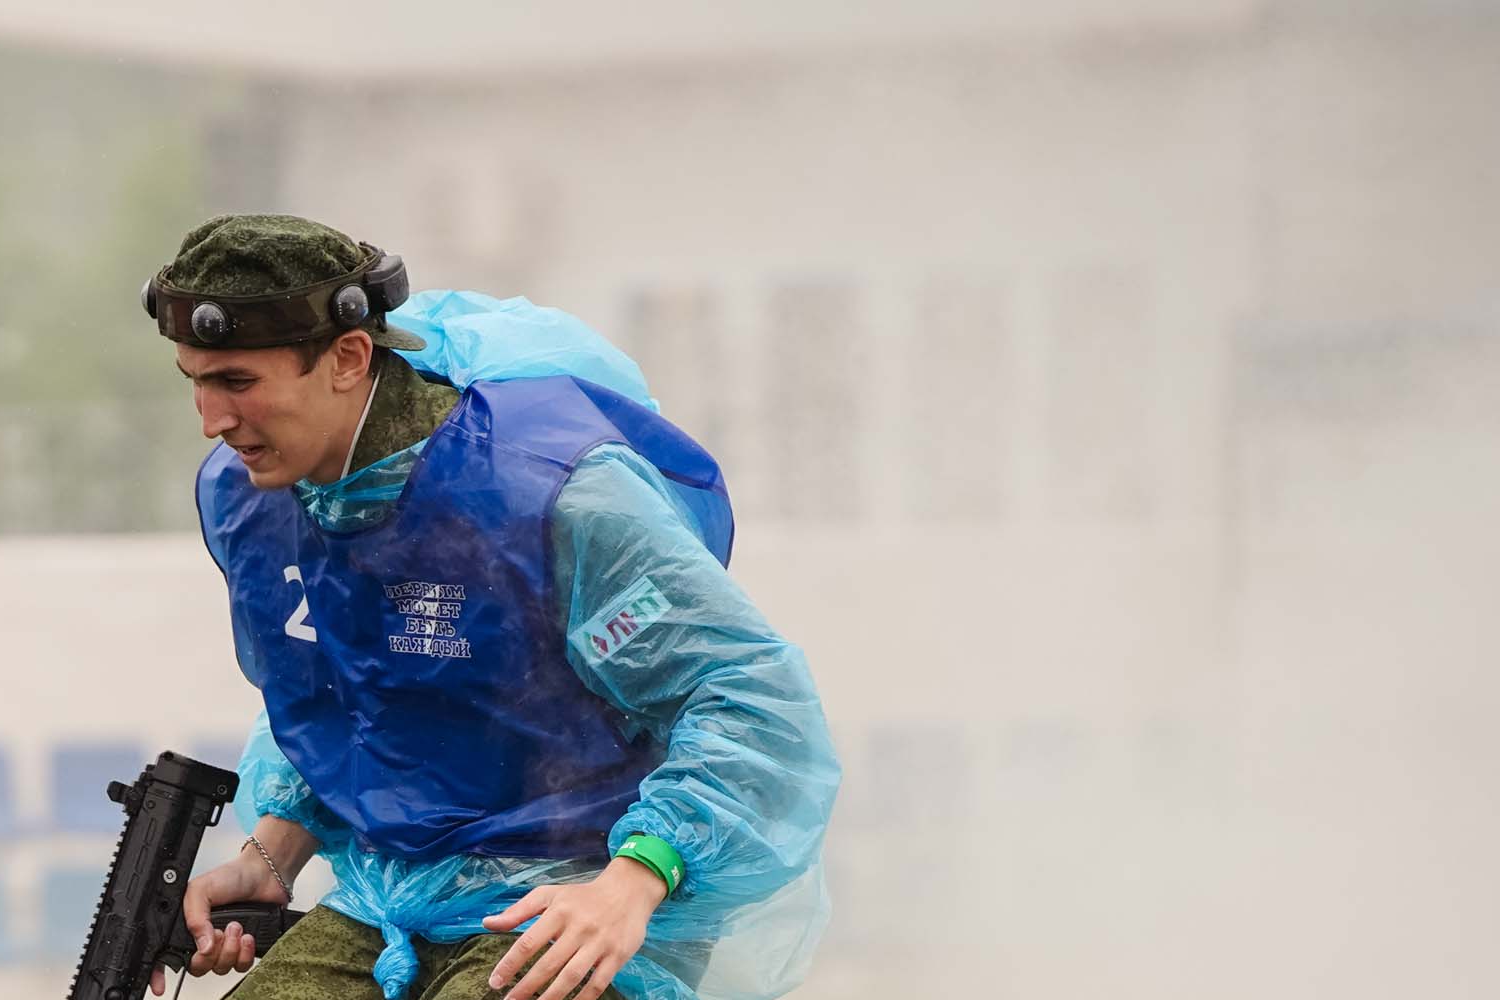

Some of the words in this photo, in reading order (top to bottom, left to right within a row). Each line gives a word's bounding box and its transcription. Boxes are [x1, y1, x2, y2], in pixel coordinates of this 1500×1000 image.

[383, 581, 466, 600] ПЕРВЫМ
[283, 565, 317, 642] 2
[399, 599, 461, 618] МОЖЕТ
[406, 618, 456, 637] БЫТЬ
[389, 636, 471, 658] КАЖДЫЙ
